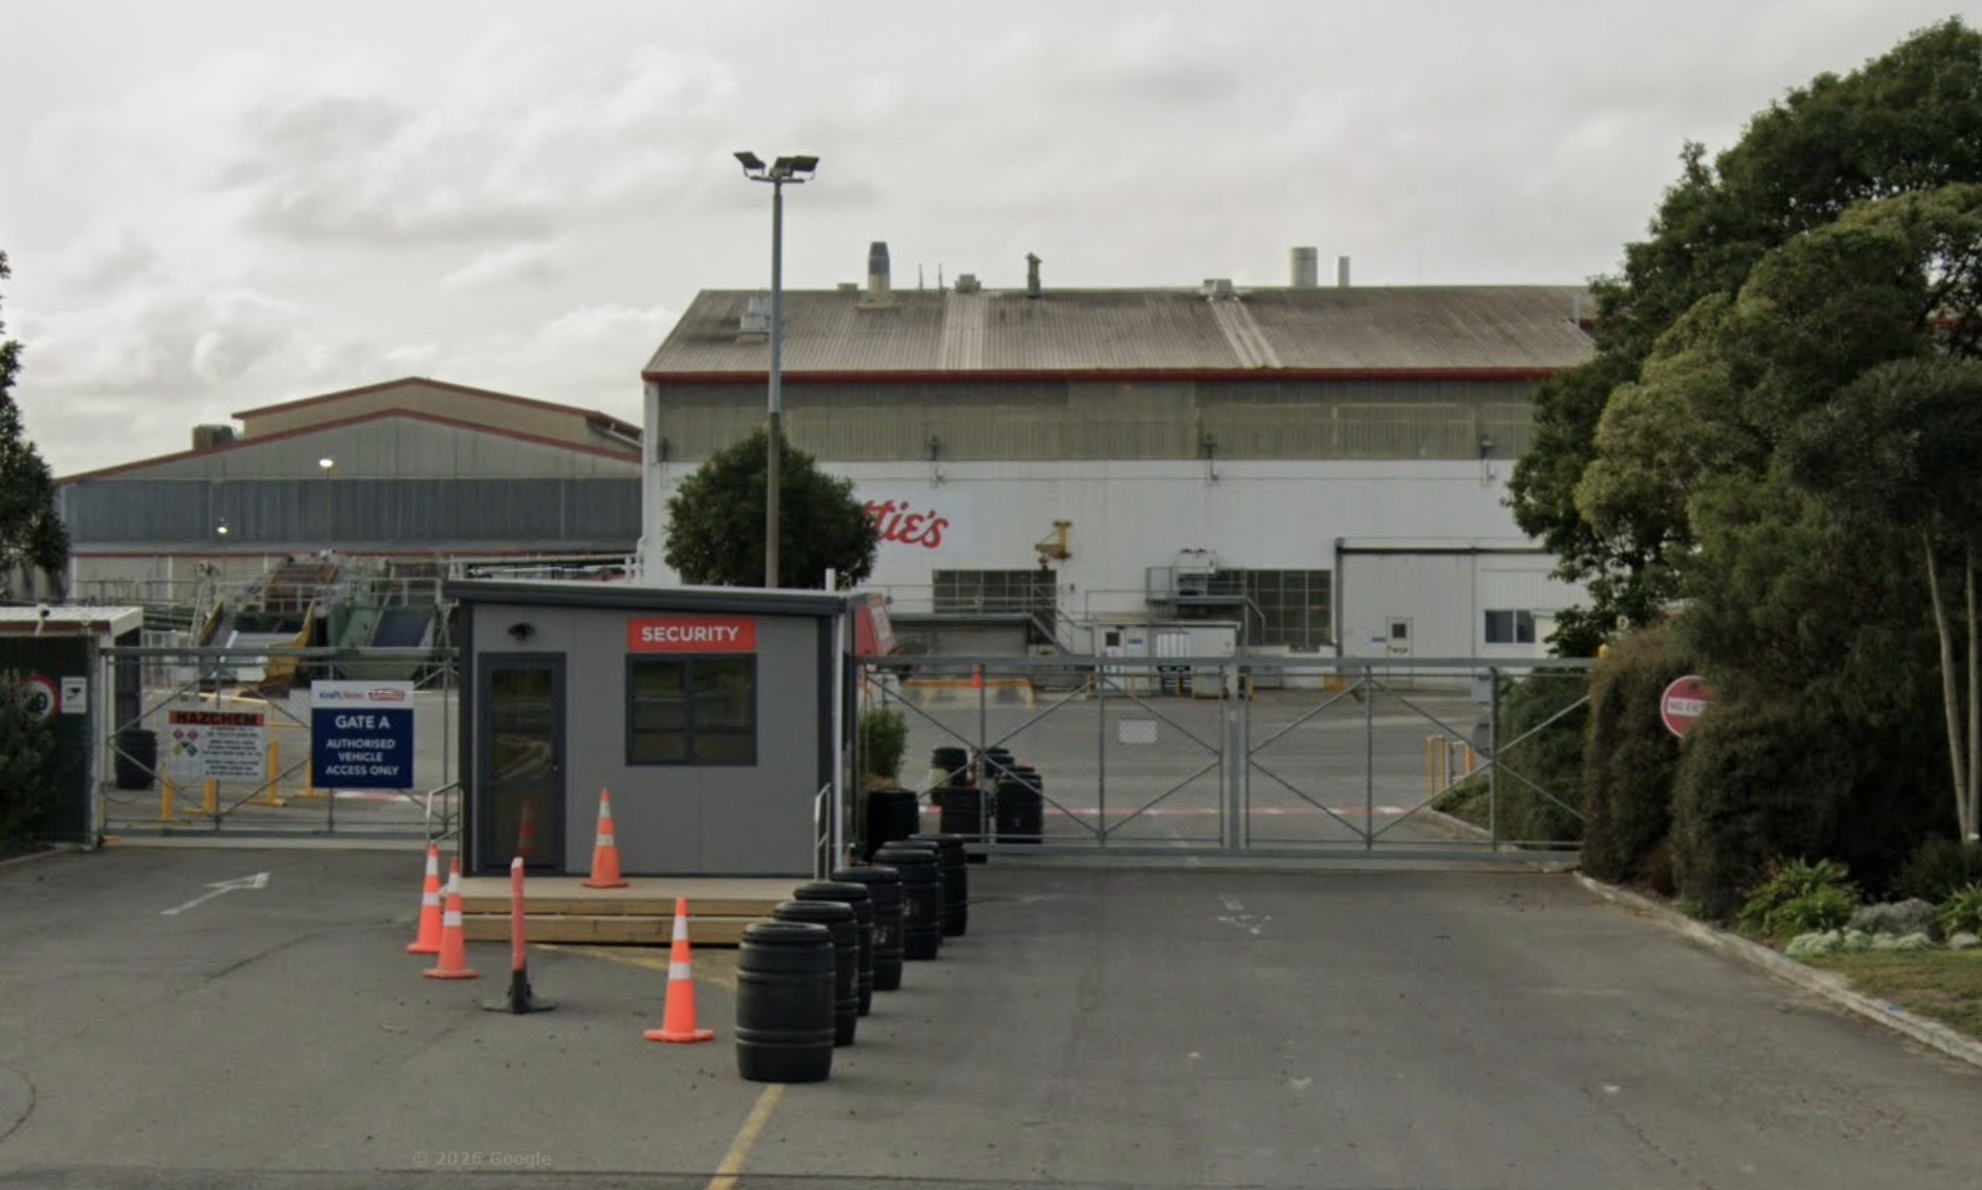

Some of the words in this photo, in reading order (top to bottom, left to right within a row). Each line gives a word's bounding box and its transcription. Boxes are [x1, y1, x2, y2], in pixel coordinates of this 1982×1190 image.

[641, 626, 739, 642] SECURITY
[177, 711, 256, 725] HAZCHEM
[335, 715, 374, 729] GATE
[378, 716, 391, 729] A
[326, 738, 396, 749] AUTHORISED
[337, 751, 383, 762] VEHICLE
[325, 765, 367, 775] ACCESS
[369, 765, 399, 775] ONLY
